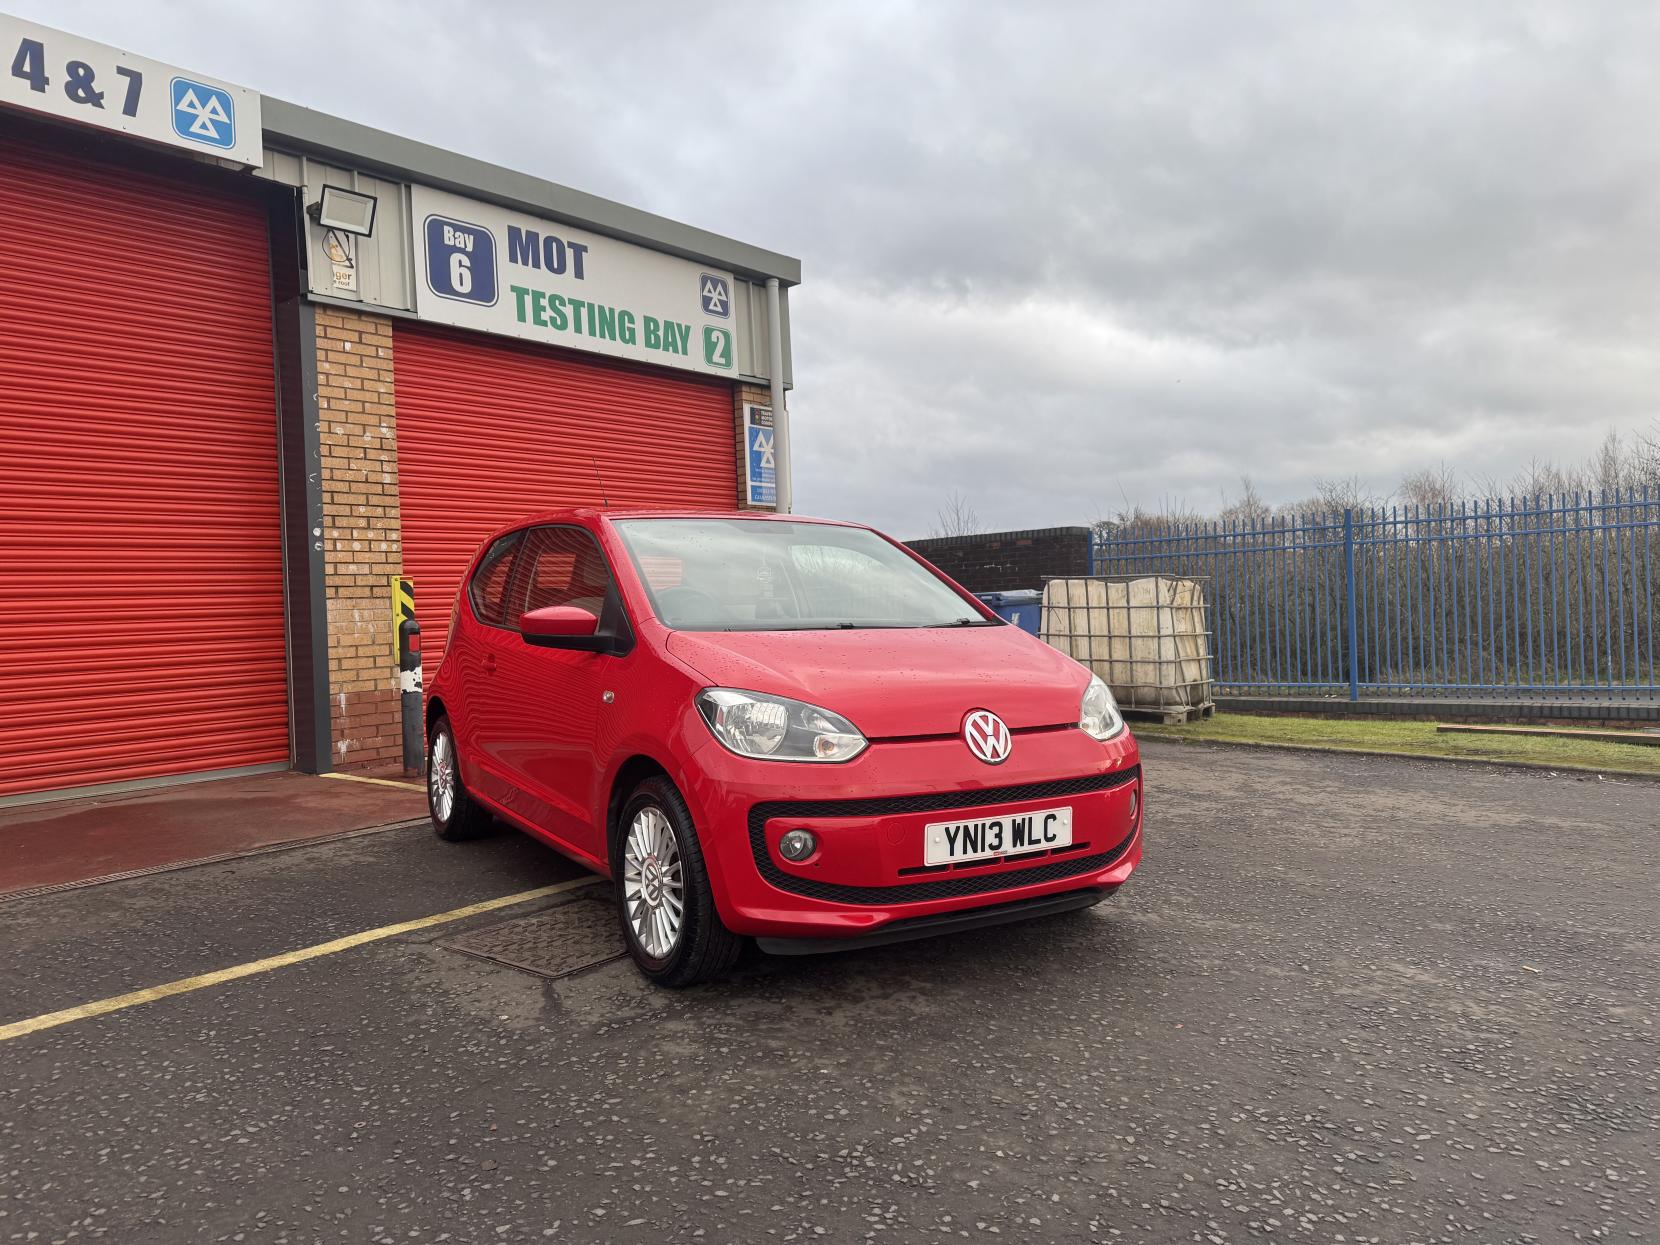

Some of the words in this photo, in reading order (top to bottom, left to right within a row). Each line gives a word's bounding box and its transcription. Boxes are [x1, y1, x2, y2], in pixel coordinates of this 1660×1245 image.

[11, 37, 50, 93] 4
[64, 60, 105, 109] &
[115, 65, 143, 117] 7
[443, 225, 475, 251] Bay
[507, 225, 589, 280] MOT
[450, 253, 472, 293] 6
[510, 285, 636, 346] TESTING
[642, 315, 691, 356] BAY
[712, 331, 726, 365] 2
[944, 821, 1003, 856] YN13
[1012, 814, 1057, 848] WLC
